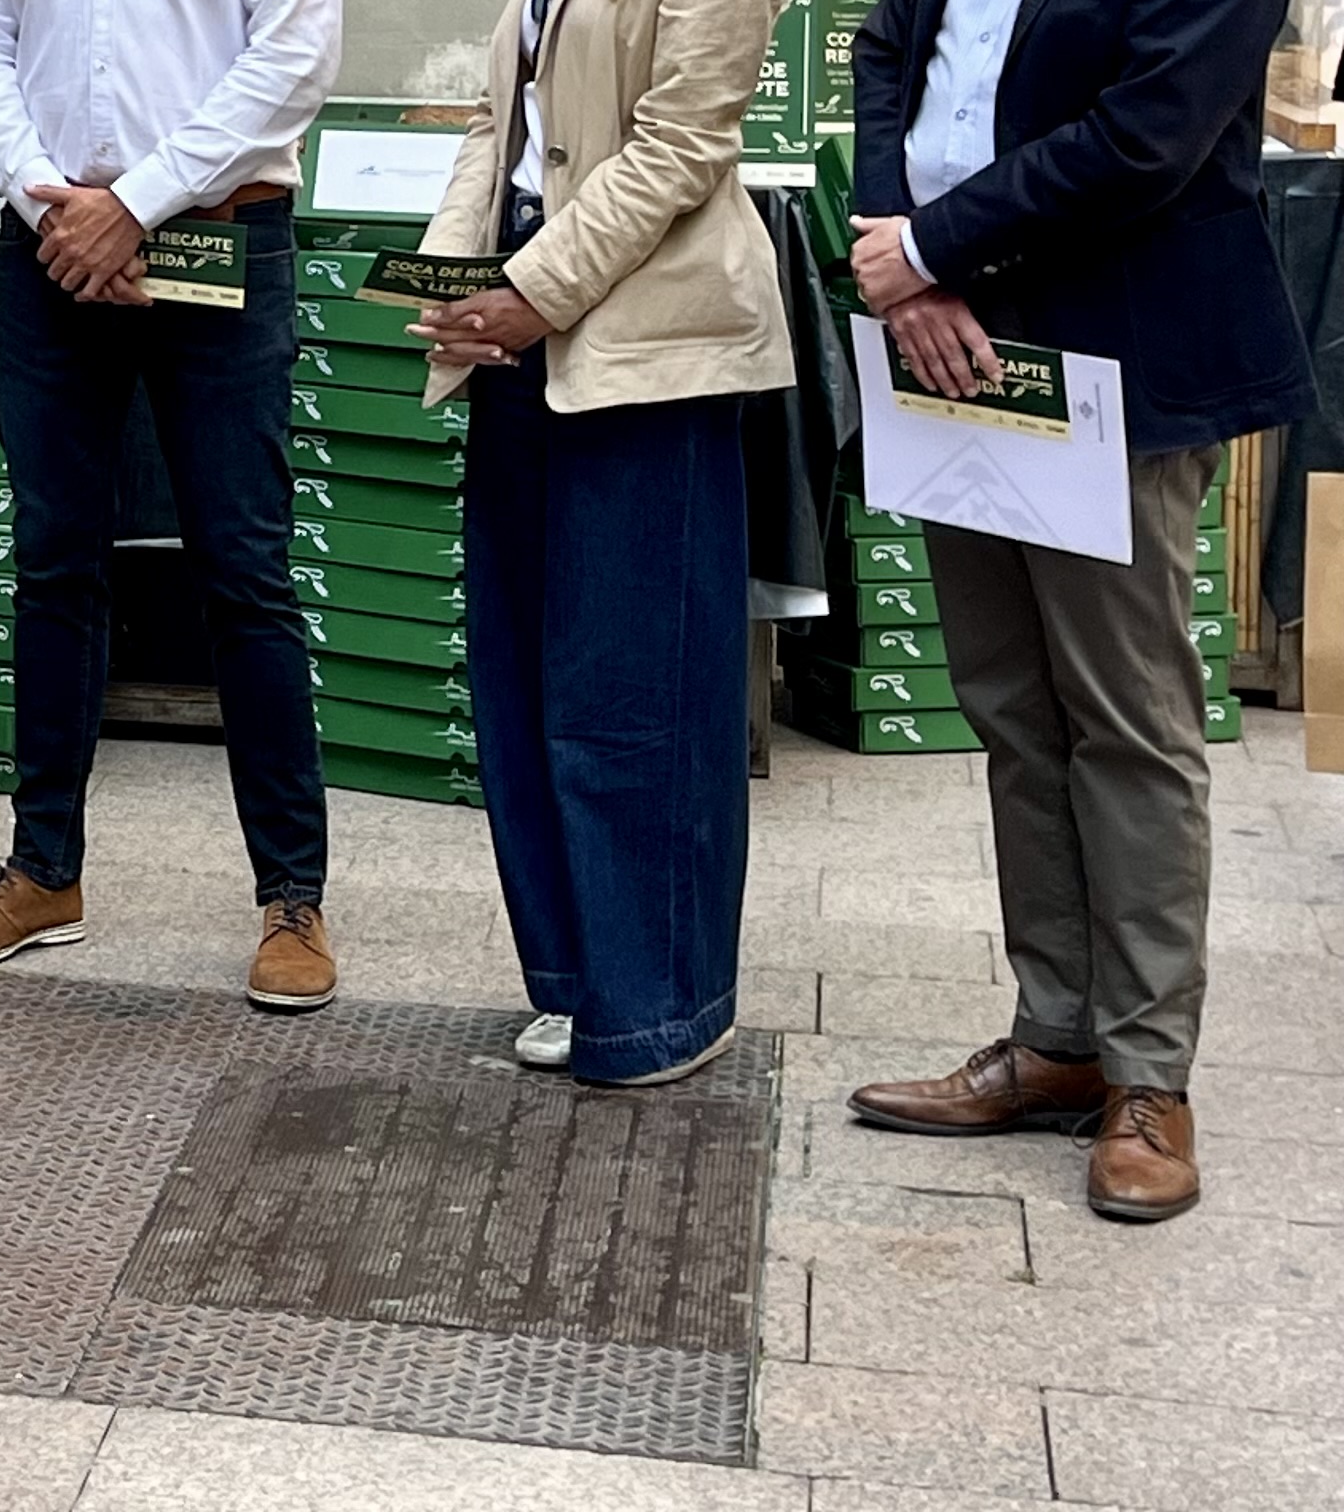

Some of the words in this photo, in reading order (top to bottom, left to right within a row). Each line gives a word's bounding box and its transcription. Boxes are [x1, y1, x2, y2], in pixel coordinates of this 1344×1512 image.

[158, 231, 234, 252] RECAPTE
[140, 250, 188, 269] LEIDA
[385, 259, 434, 276] COCA
[437, 266, 463, 278] DE
